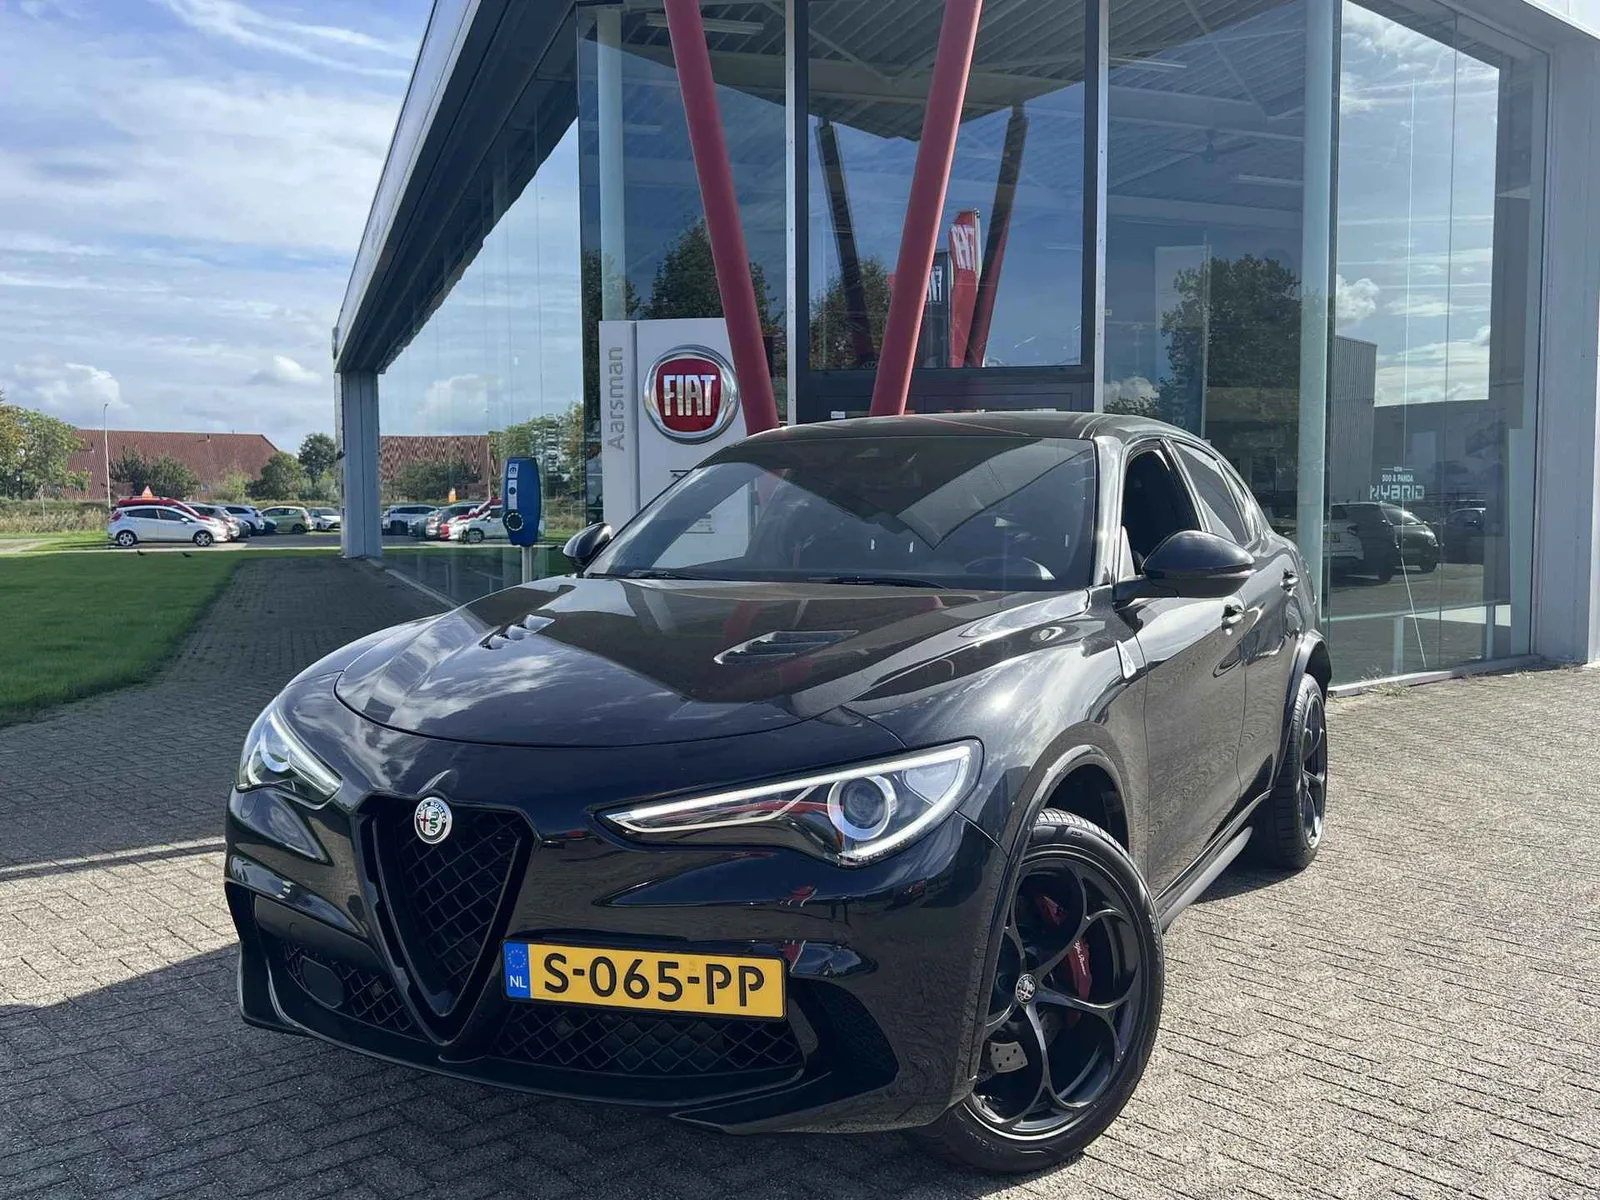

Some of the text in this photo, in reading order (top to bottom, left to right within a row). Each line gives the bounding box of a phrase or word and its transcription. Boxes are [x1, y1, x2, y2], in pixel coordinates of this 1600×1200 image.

[607, 346, 625, 452] Aarsman
[663, 374, 716, 417] FIAT
[1370, 485, 1424, 500] HYBRID
[509, 975, 527, 989] NL
[543, 952, 765, 1007] S-065-PP
